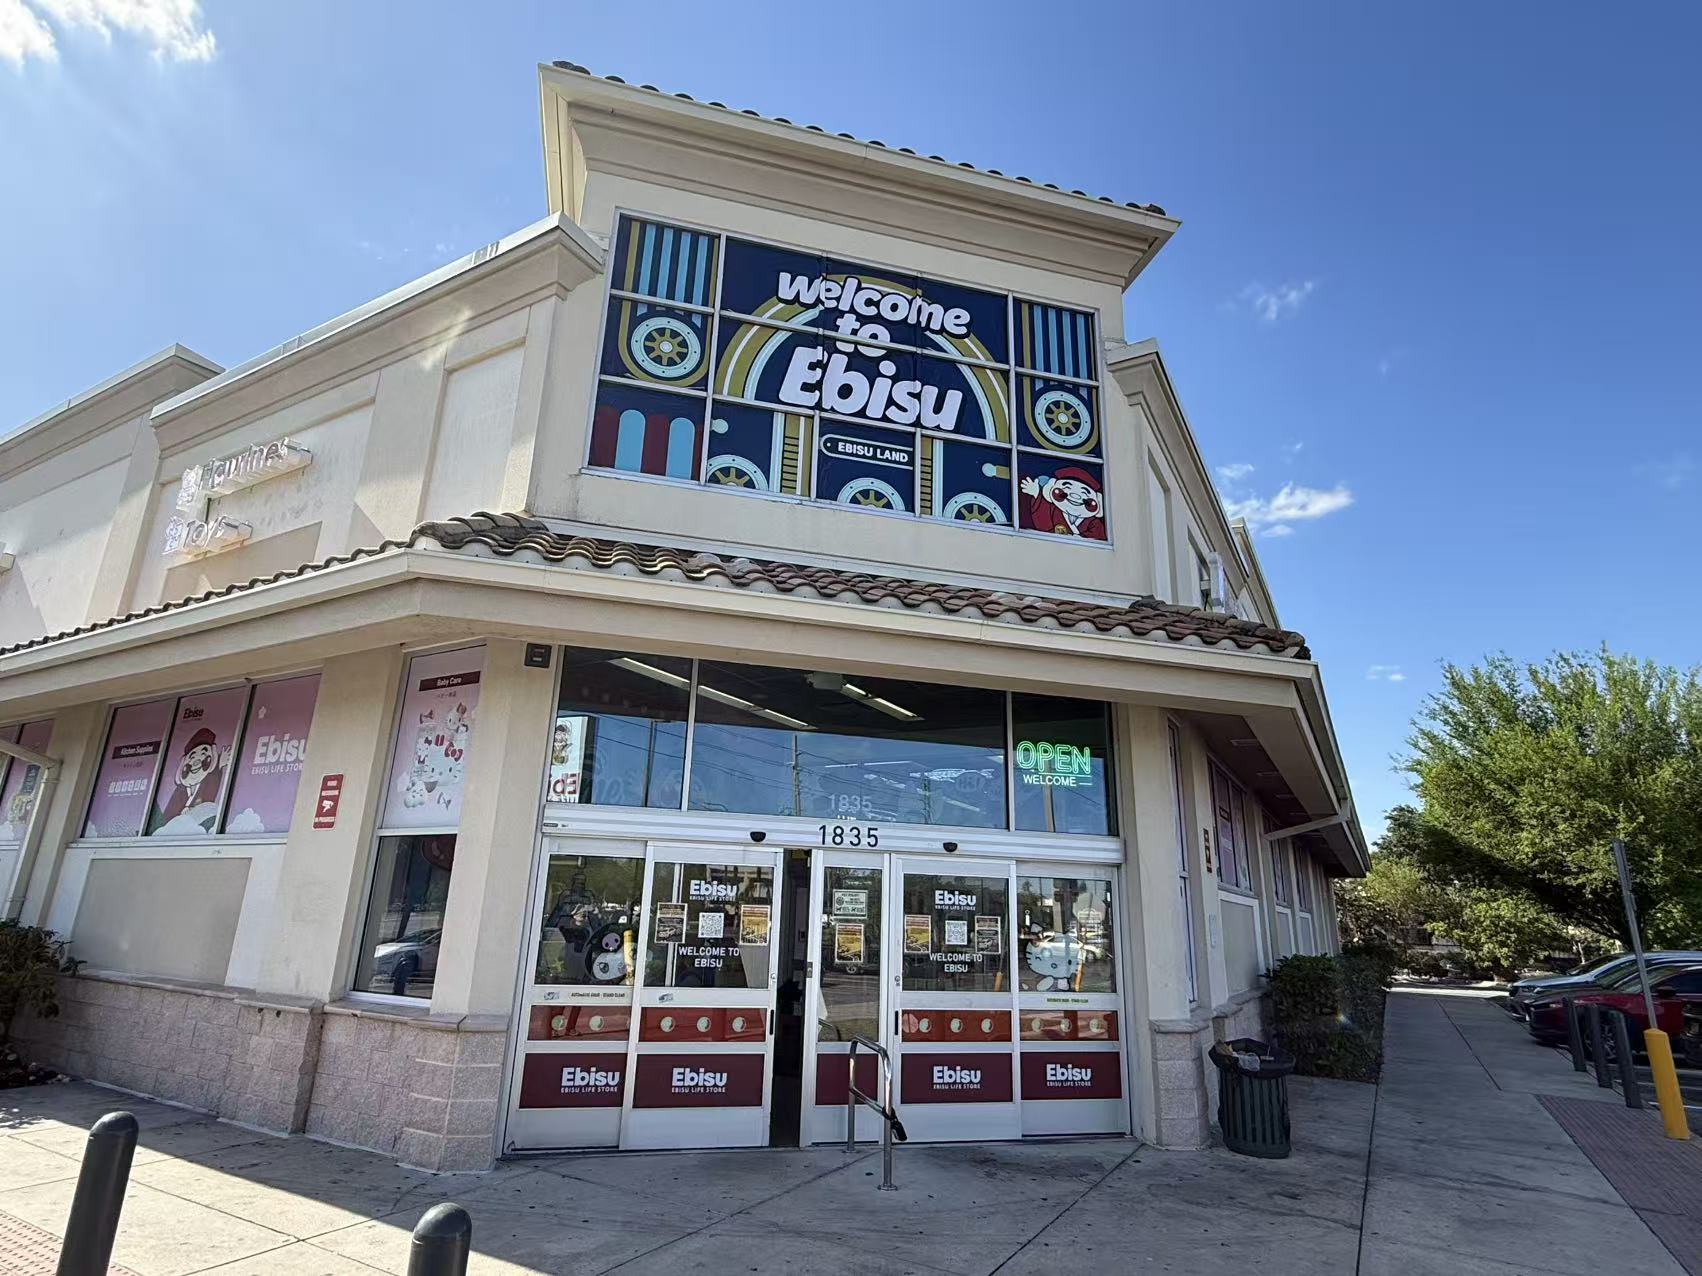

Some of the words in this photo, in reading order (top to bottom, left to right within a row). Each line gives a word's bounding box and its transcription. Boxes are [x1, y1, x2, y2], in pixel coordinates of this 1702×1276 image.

[777, 270, 971, 338] welcome
[835, 313, 891, 357] to
[778, 345, 963, 431] Ebisu
[837, 442, 873, 459] EBISU
[875, 447, 909, 463] LAND
[436, 679, 449, 687] Baby
[450, 677, 462, 685] Care
[183, 707, 204, 719] Ebisu
[1016, 740, 1091, 774] OPEN
[251, 766, 268, 775] EBISU
[270, 765, 284, 773] LIFE
[285, 762, 304, 773] STOR
[1023, 775, 1077, 786] WELCOME
[818, 825, 879, 847] 1835
[689, 880, 737, 895] Ebisu
[934, 890, 977, 905] Ebisu
[679, 946, 726, 957] WELCOME
[728, 947, 740, 957] TO
[929, 952, 971, 962] WELCOME
[972, 953, 983, 962] TO
[694, 958, 723, 968] EBISU
[944, 963, 969, 973] EBISU
[561, 1067, 620, 1087] Ebisu
[672, 1067, 728, 1087] Ebisu
[933, 1065, 981, 1084] Ebisu
[1046, 1063, 1092, 1082] Ebisu
